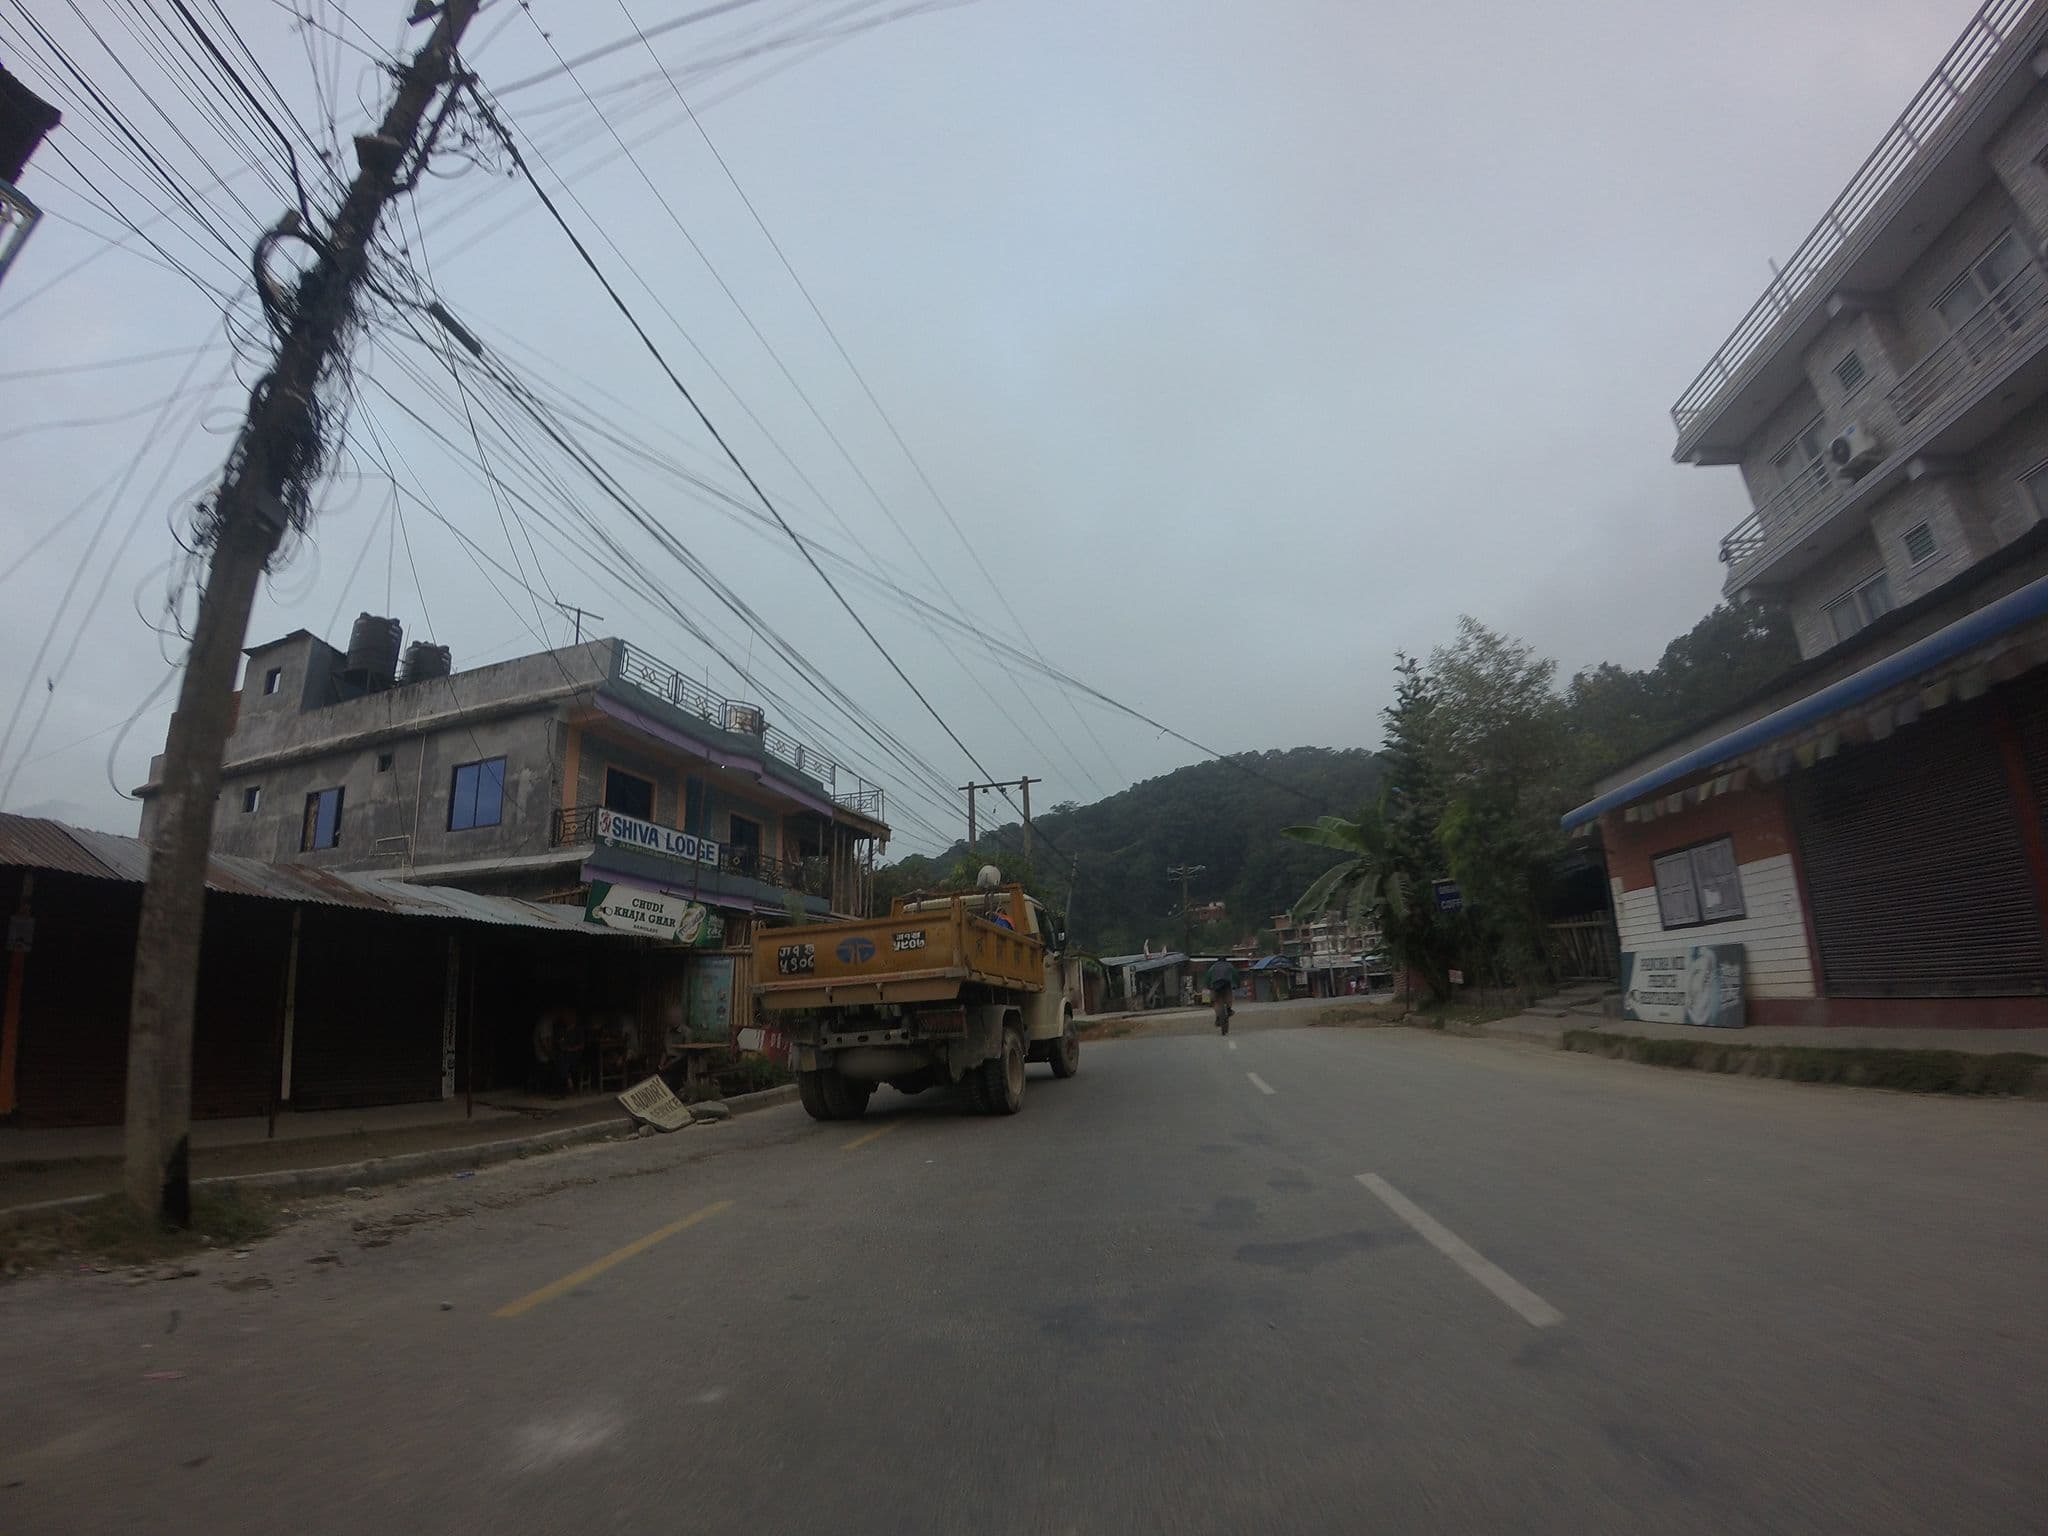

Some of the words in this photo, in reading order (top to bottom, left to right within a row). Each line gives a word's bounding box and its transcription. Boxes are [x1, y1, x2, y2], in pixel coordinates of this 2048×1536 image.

[612, 816, 659, 848] SHIVA
[666, 832, 715, 862] LODGE
[614, 906, 646, 924] KHAJA
[648, 914, 676, 928] GHAR
[632, 898, 664, 914] CHUDI
